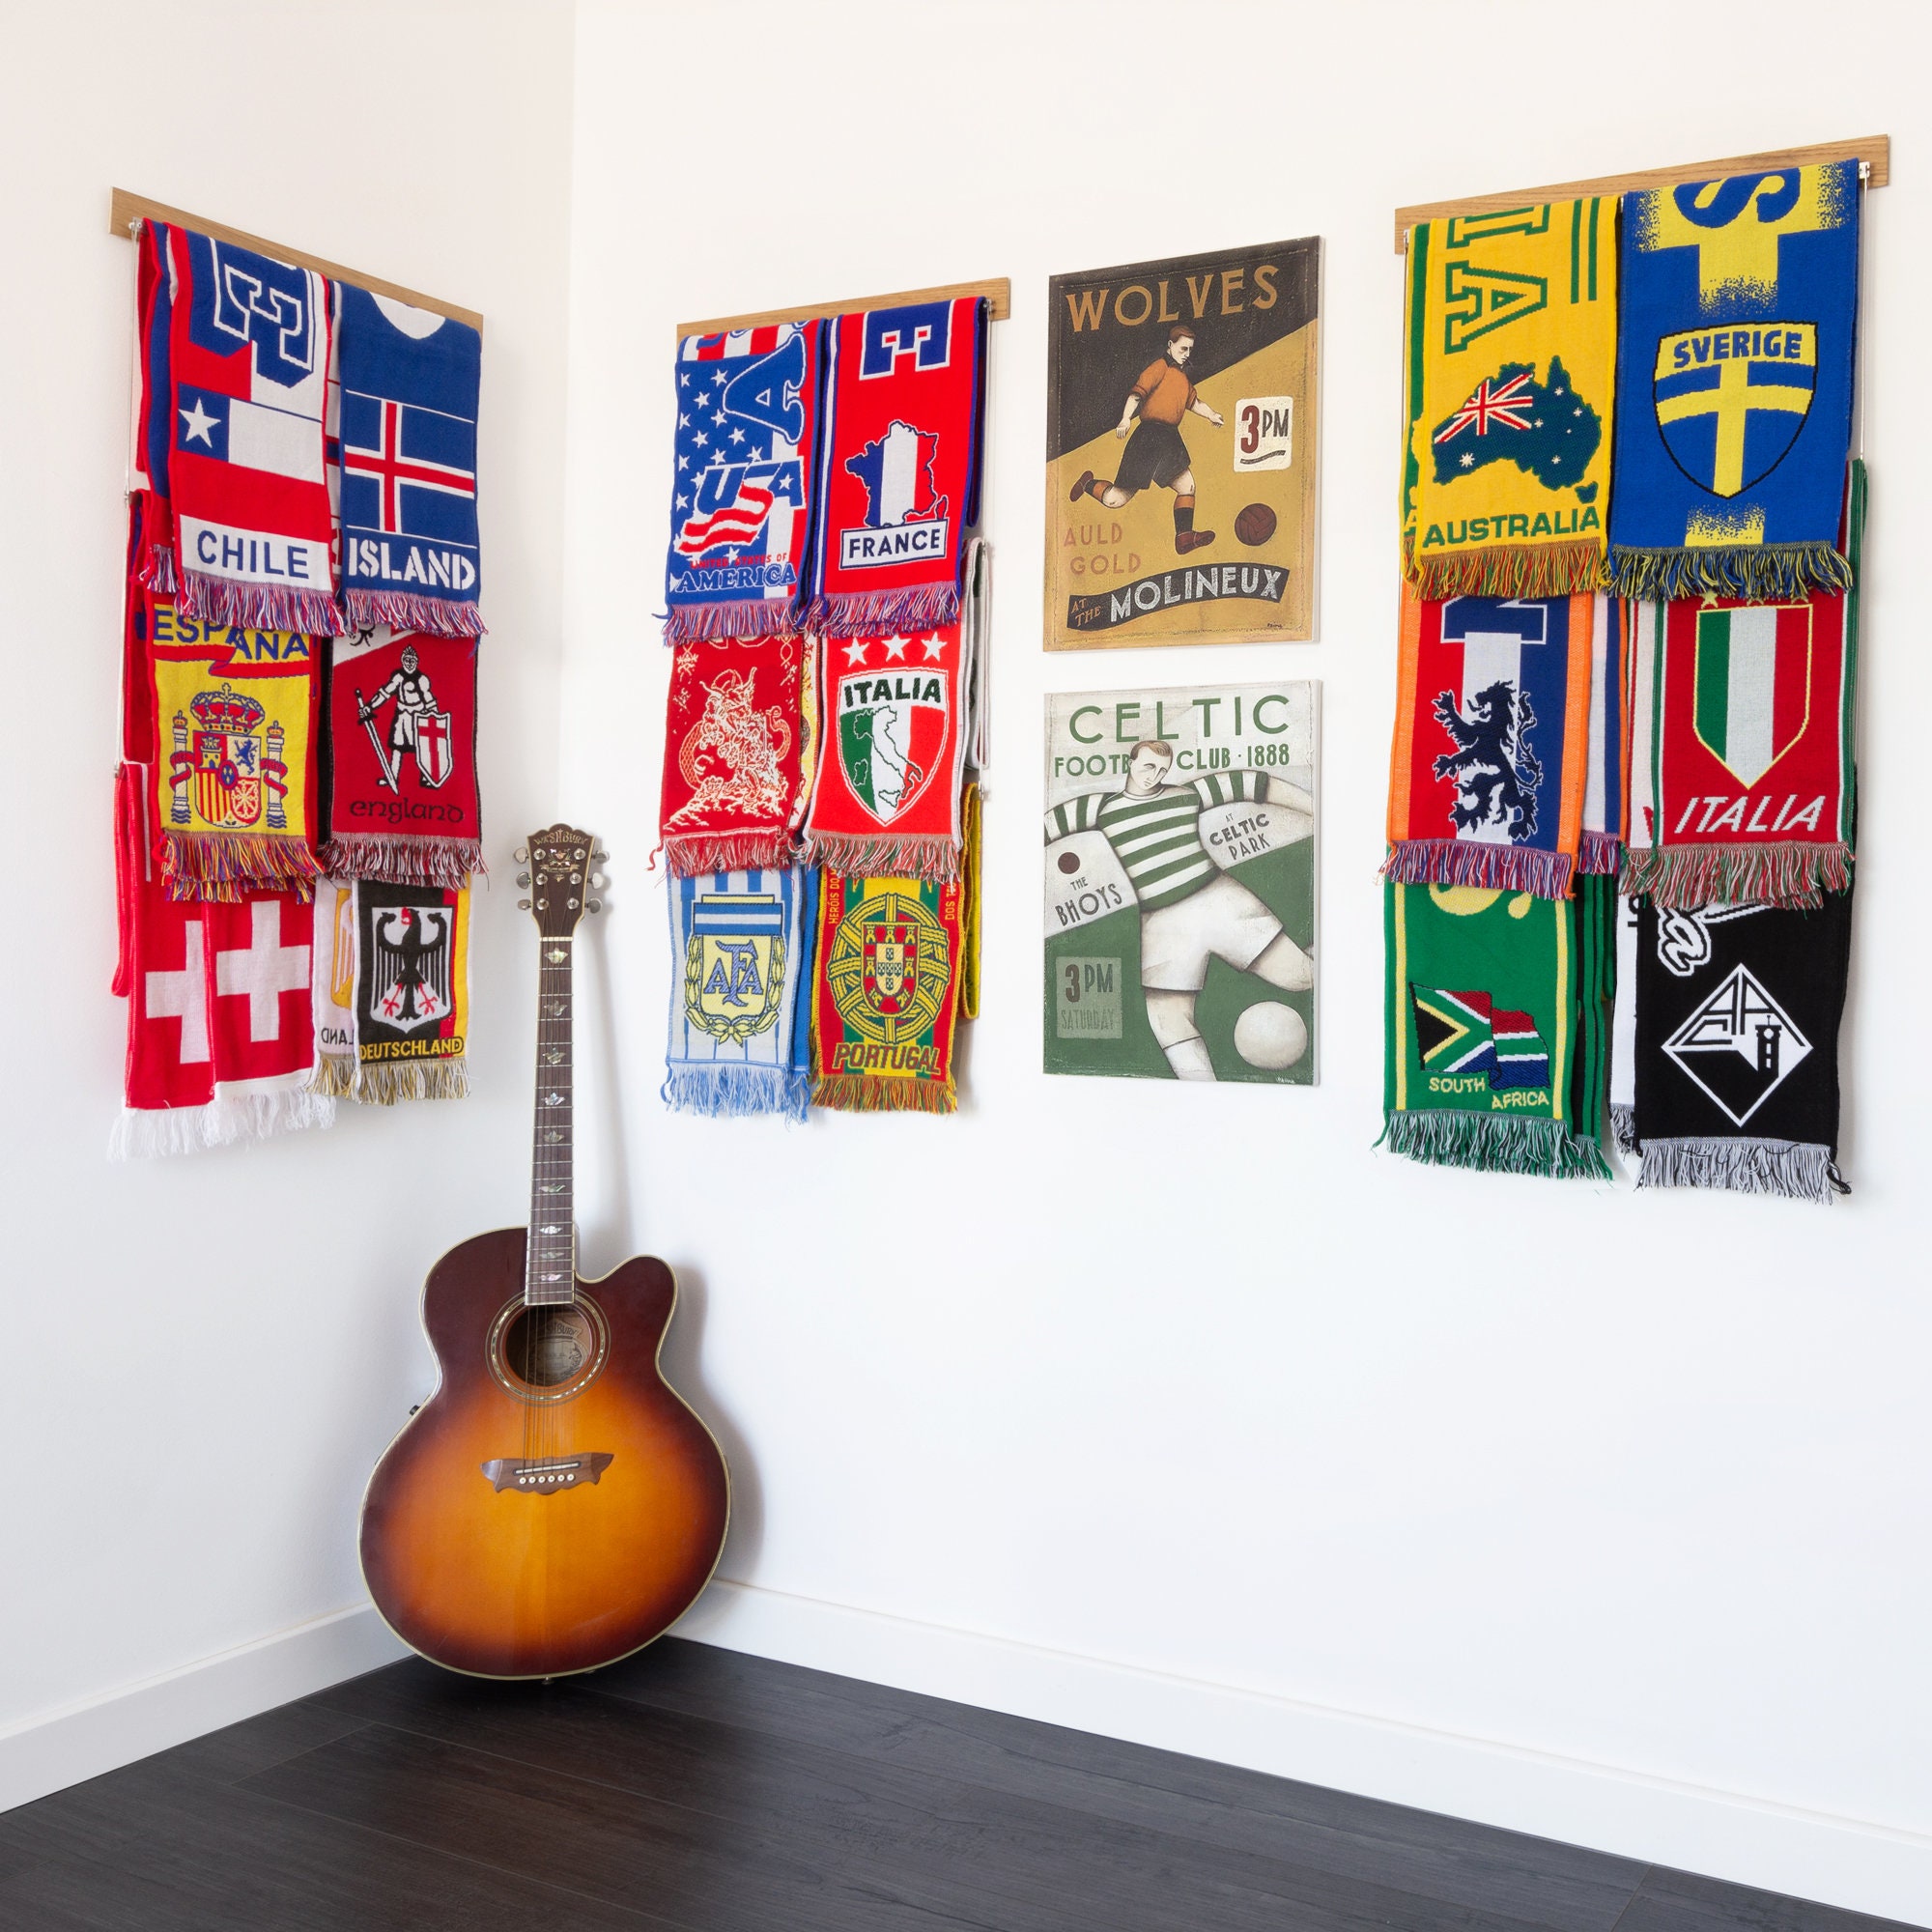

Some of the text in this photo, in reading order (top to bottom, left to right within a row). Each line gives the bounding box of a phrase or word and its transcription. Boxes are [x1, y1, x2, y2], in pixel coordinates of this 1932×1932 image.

[1065, 265, 1279, 332] WOLVES
[1674, 329, 1803, 368] SVERIGE
[679, 456, 807, 554] USA
[1064, 523, 1123, 547] AULD
[1422, 505, 1600, 548] AUSTRALIA
[197, 529, 309, 580] CHILE
[849, 528, 941, 558] FRANCE
[348, 537, 475, 590] ISLAND
[690, 553, 786, 569] UNITED STATES OF
[1070, 553, 1141, 575] GOLD
[675, 562, 797, 593] AMERICA
[1071, 566, 1281, 628] AT THE MOLINEUX
[844, 677, 941, 707] ITALIA
[1069, 695, 1290, 744] CELTIC
[1054, 744, 1290, 777] FOOTB CLUB 1888
[350, 797, 465, 824] england
[1225, 813, 1234, 823] AT
[1674, 794, 1826, 834] ITALIA
[1209, 813, 1270, 845] CELTIC
[1228, 833, 1270, 860] PARK
[1070, 877, 1088, 891] THE
[1055, 883, 1122, 926] BHOYS
[702, 939, 764, 1007] AFA
[1061, 1008, 1115, 1031] SATURDAY
[359, 1036, 465, 1060] DEUTSCHLAND
[832, 1042, 941, 1075] PORTUGAL
[1429, 1077, 1549, 1109] SOUTH AFRICA
